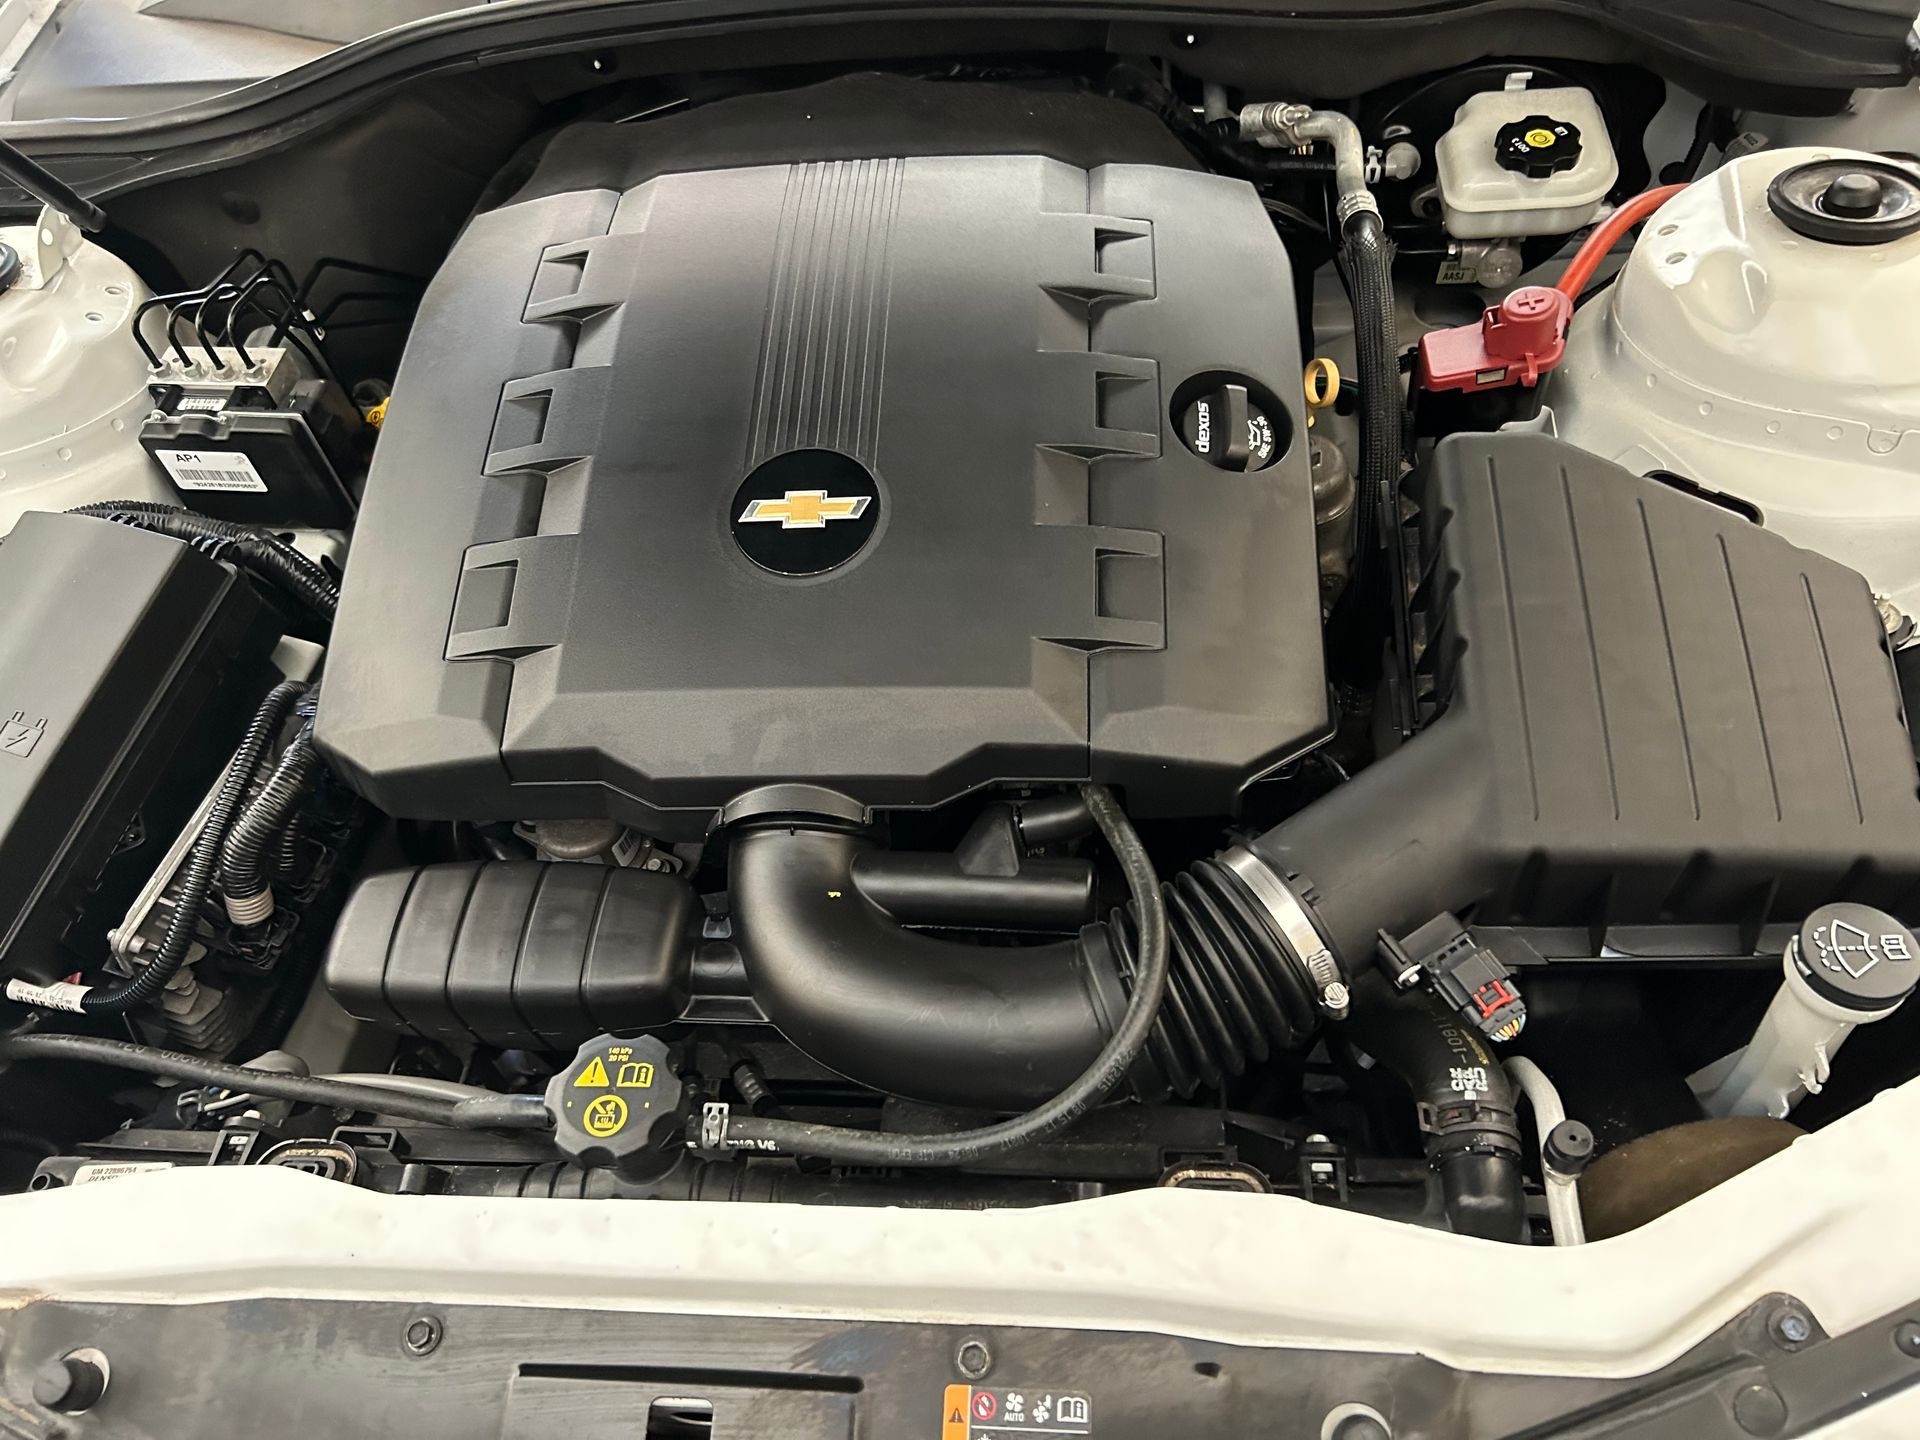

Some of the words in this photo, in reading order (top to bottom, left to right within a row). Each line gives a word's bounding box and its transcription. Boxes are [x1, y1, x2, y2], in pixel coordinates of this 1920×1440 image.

[1195, 400, 1210, 453] dexos
[1257, 442, 1272, 459] SAE
[175, 453, 202, 463] AP1
[608, 1047, 620, 1055] 140
[620, 1047, 633, 1055] kPa
[1448, 1067, 1487, 1080] UPR
[1450, 1079, 1489, 1091] RAD
[1003, 1412, 1025, 1422] AUTO
